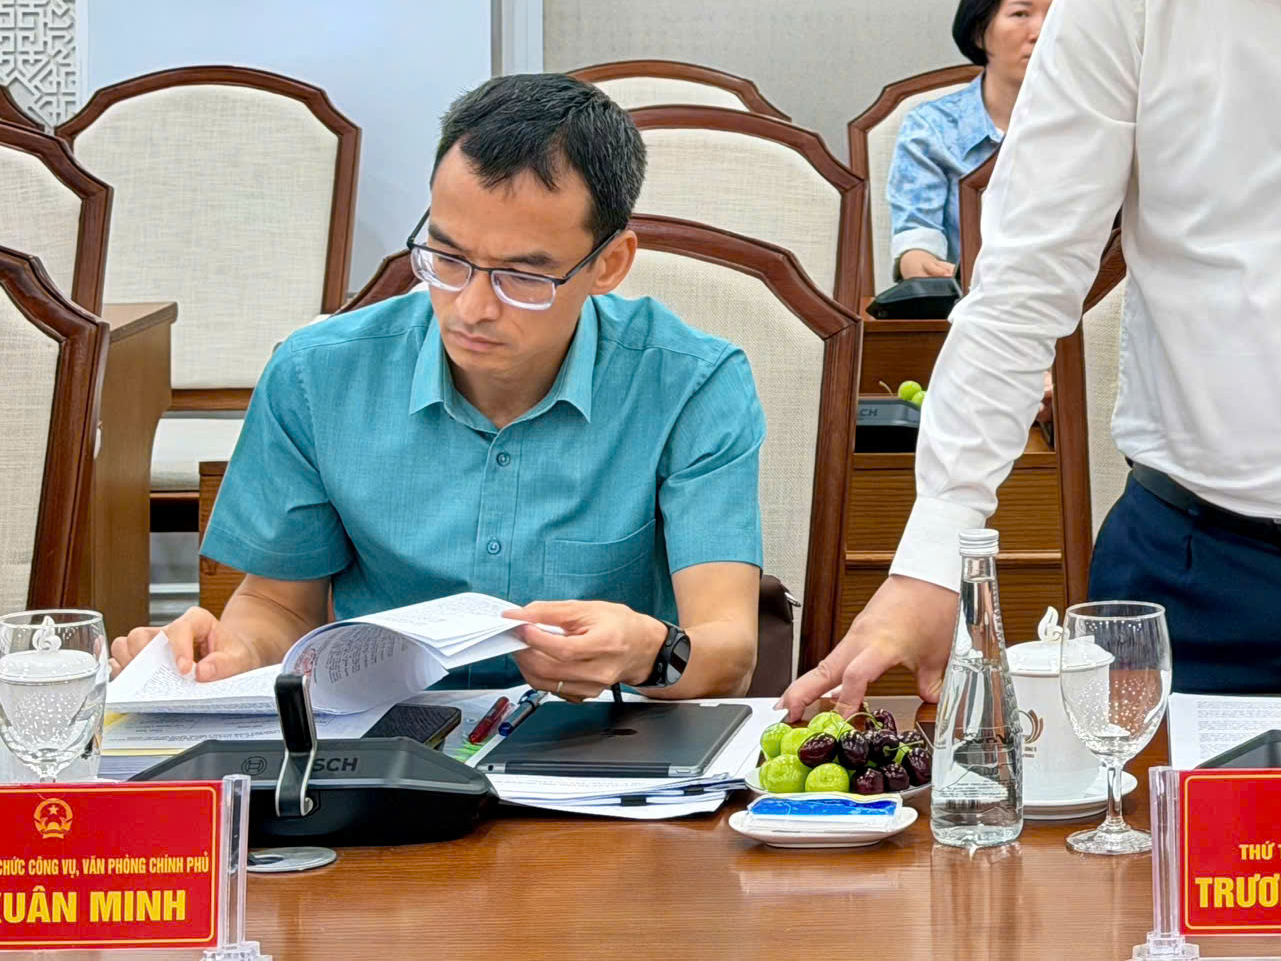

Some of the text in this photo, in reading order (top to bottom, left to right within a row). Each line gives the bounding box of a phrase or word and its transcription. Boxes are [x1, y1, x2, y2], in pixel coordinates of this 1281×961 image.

[1238, 840, 1277, 861] THỨ
[28, 855, 60, 876] CÔNG
[82, 855, 106, 875] VĂN
[108, 855, 147, 875] PHÒNG
[149, 854, 184, 874] CHÍNH
[186, 851, 210, 873] PHỦ
[0, 885, 187, 924] UÂN MINH
